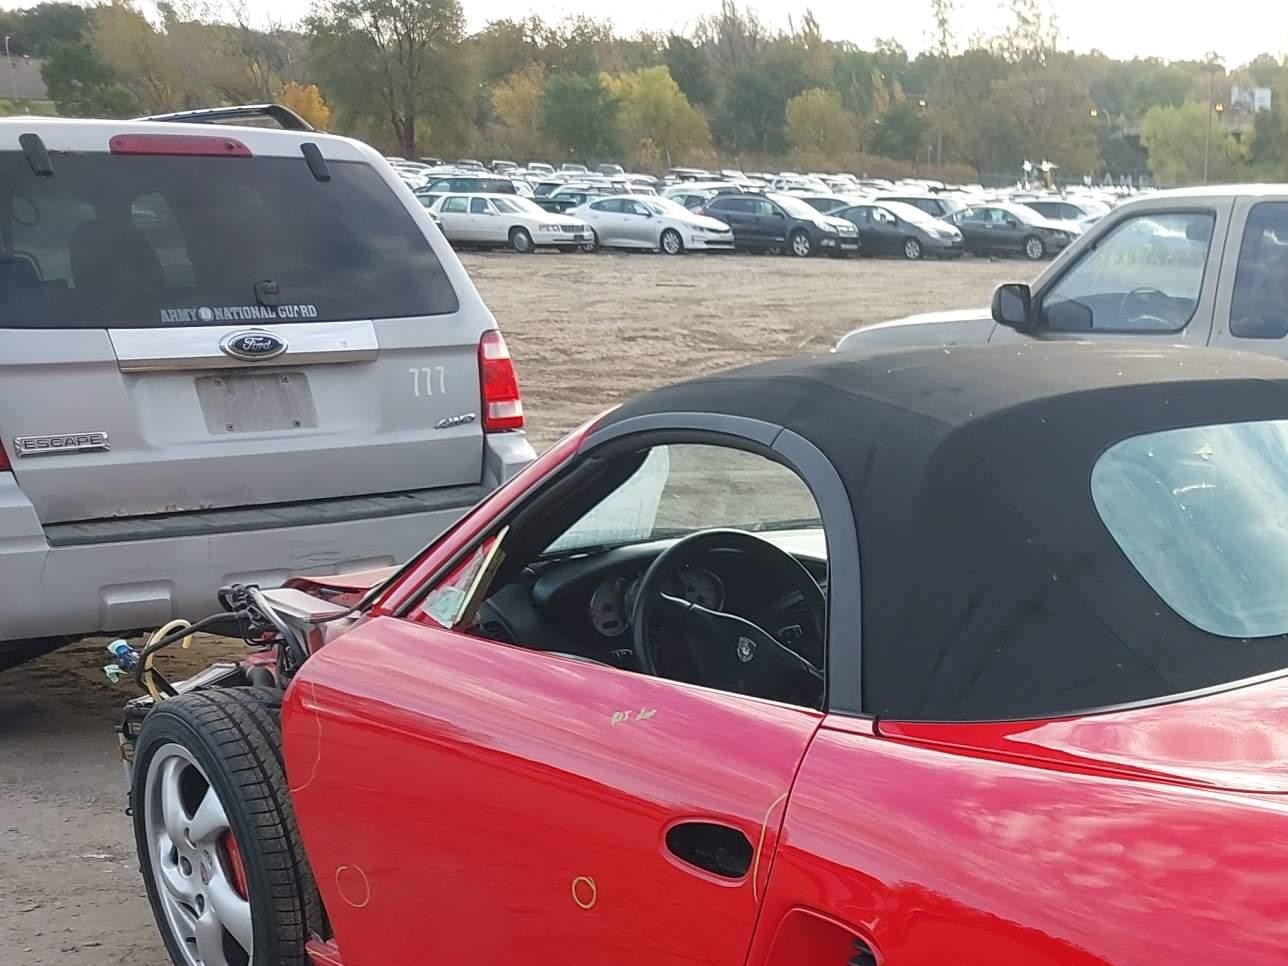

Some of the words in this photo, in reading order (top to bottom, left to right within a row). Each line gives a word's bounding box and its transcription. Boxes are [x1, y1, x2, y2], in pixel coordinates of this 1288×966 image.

[160, 307, 198, 323] ARMY
[212, 305, 277, 321] NATIONAL
[242, 336, 273, 352] Ford
[408, 365, 447, 397] 777
[23, 434, 102, 450] ESCAPE
